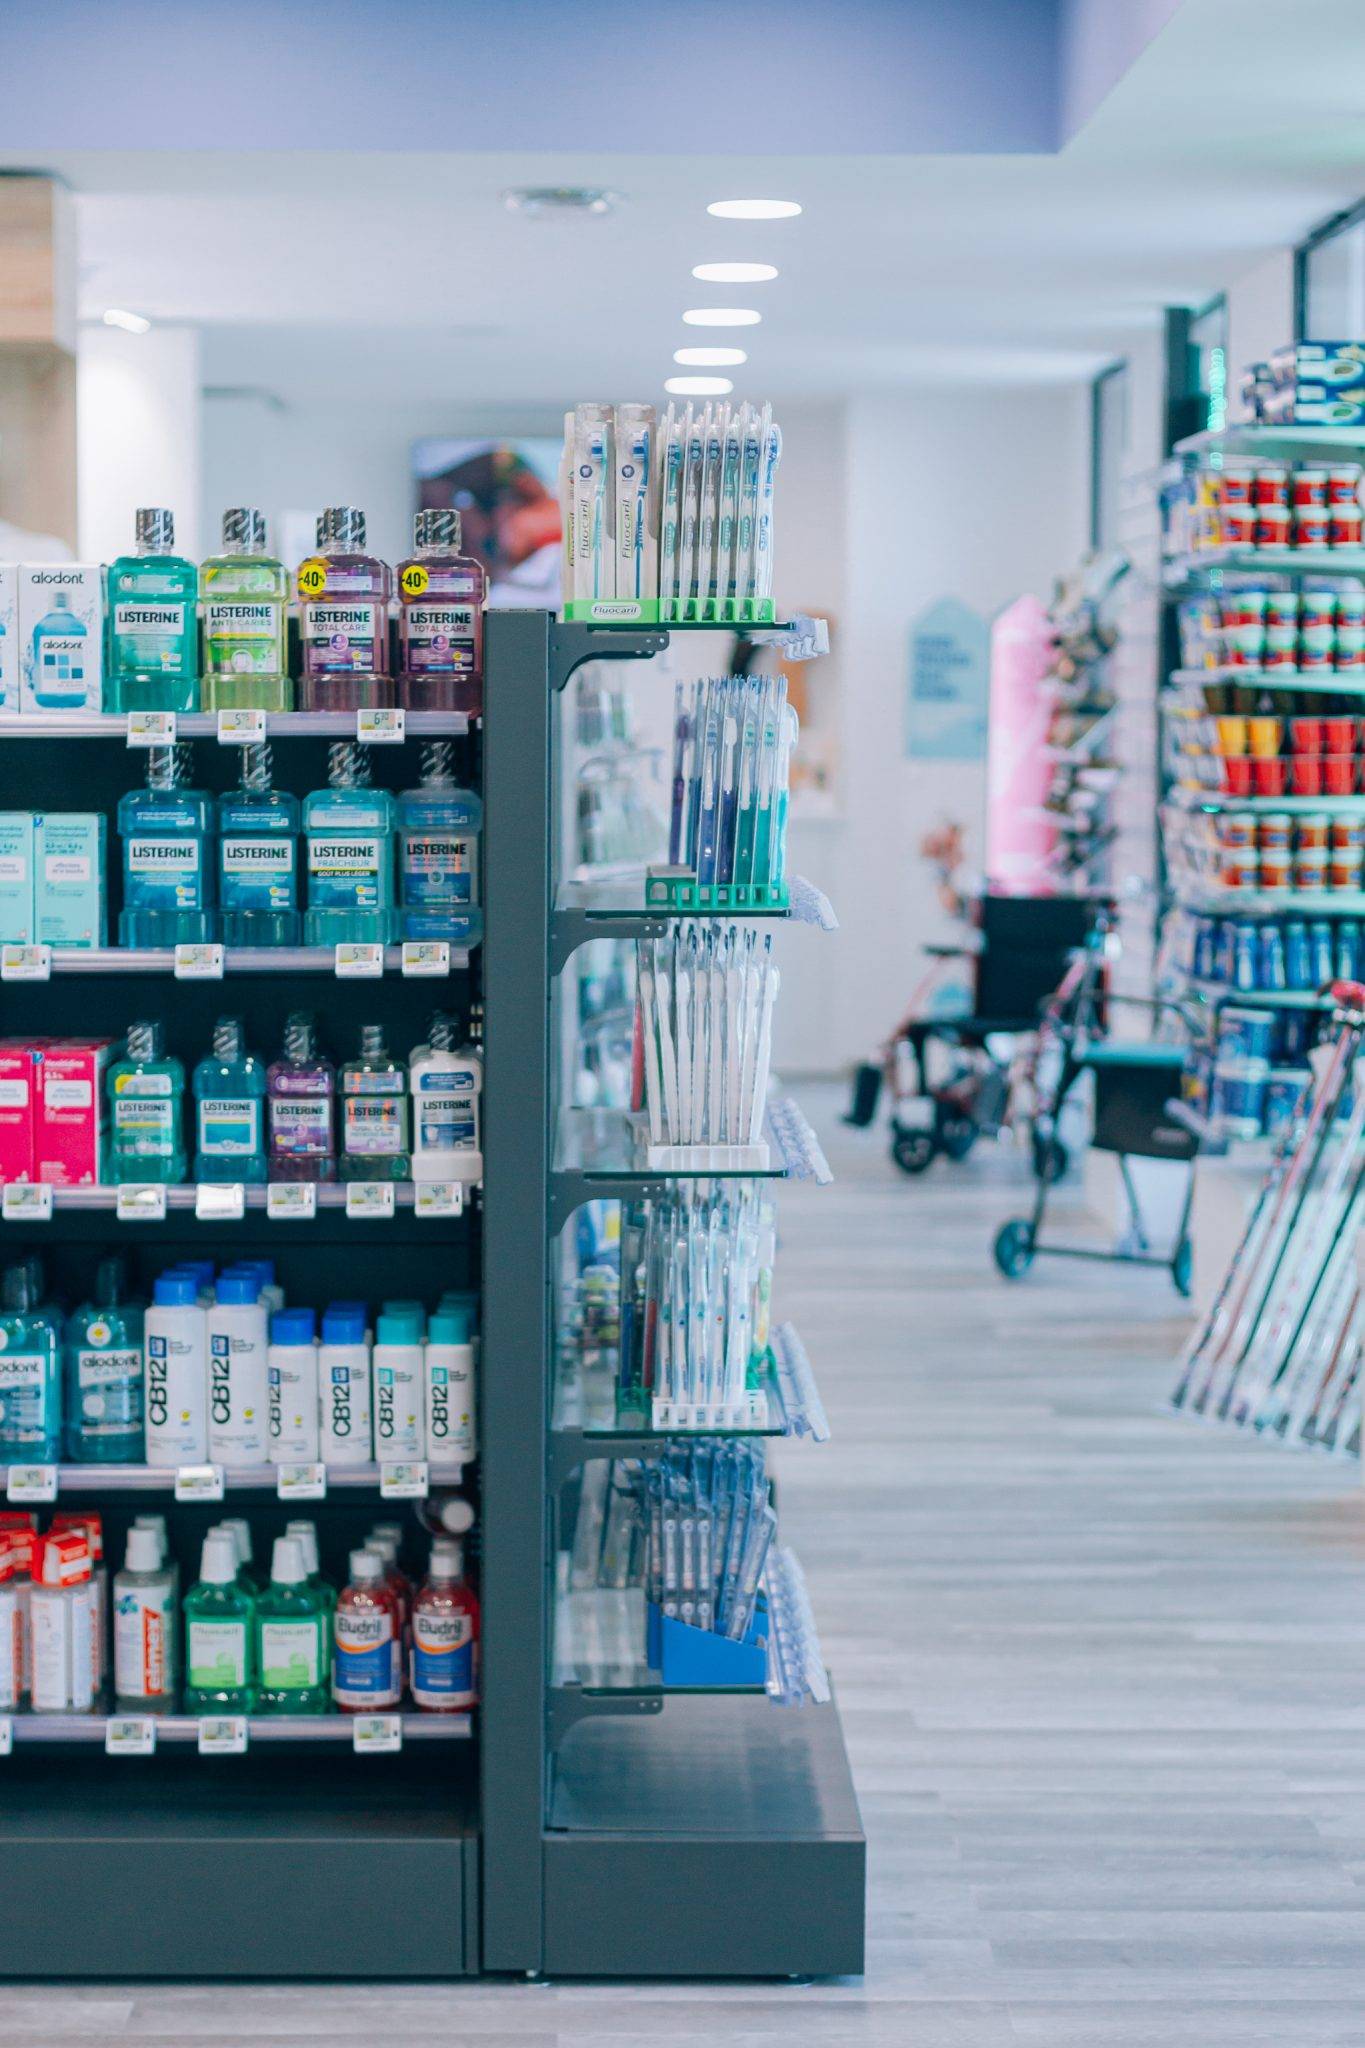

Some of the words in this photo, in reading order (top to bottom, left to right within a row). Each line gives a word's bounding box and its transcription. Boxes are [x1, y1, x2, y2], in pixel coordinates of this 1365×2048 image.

[580, 499, 590, 559] Fluocaril
[621, 499, 631, 559] Fluocaril
[31, 571, 84, 584] alodont
[211, 606, 272, 618] LISTERINE
[593, 605, 637, 614] Fluocaril
[119, 611, 180, 623] LISTERINE
[310, 611, 370, 622] LISTERINE
[410, 612, 471, 624] LISTERINE
[313, 624, 339, 632] TOTAL
[342, 624, 367, 632] CARE
[414, 625, 440, 633] TOTAL
[443, 625, 468, 633] CARE
[43, 640, 83, 649] alodont
[132, 847, 194, 858] LISTERINE
[227, 847, 288, 858] LISTERINE
[314, 846, 374, 857] LISTERINE
[406, 843, 467, 855] LISTERINE
[118, 1103, 166, 1112] LISTERINE
[204, 1102, 252, 1111] LISTERINE
[276, 1105, 325, 1115] LISTERINE
[423, 1100, 471, 1110] LISTERINE
[348, 1106, 396, 1116] LISTERINE
[82, 1354, 139, 1368] alodont
[149, 1360, 167, 1426] CB12
[212, 1358, 230, 1424] CB12
[332, 1384, 351, 1437] CB12
[380, 1386, 394, 1438] CB12
[432, 1386, 448, 1438] CB12
